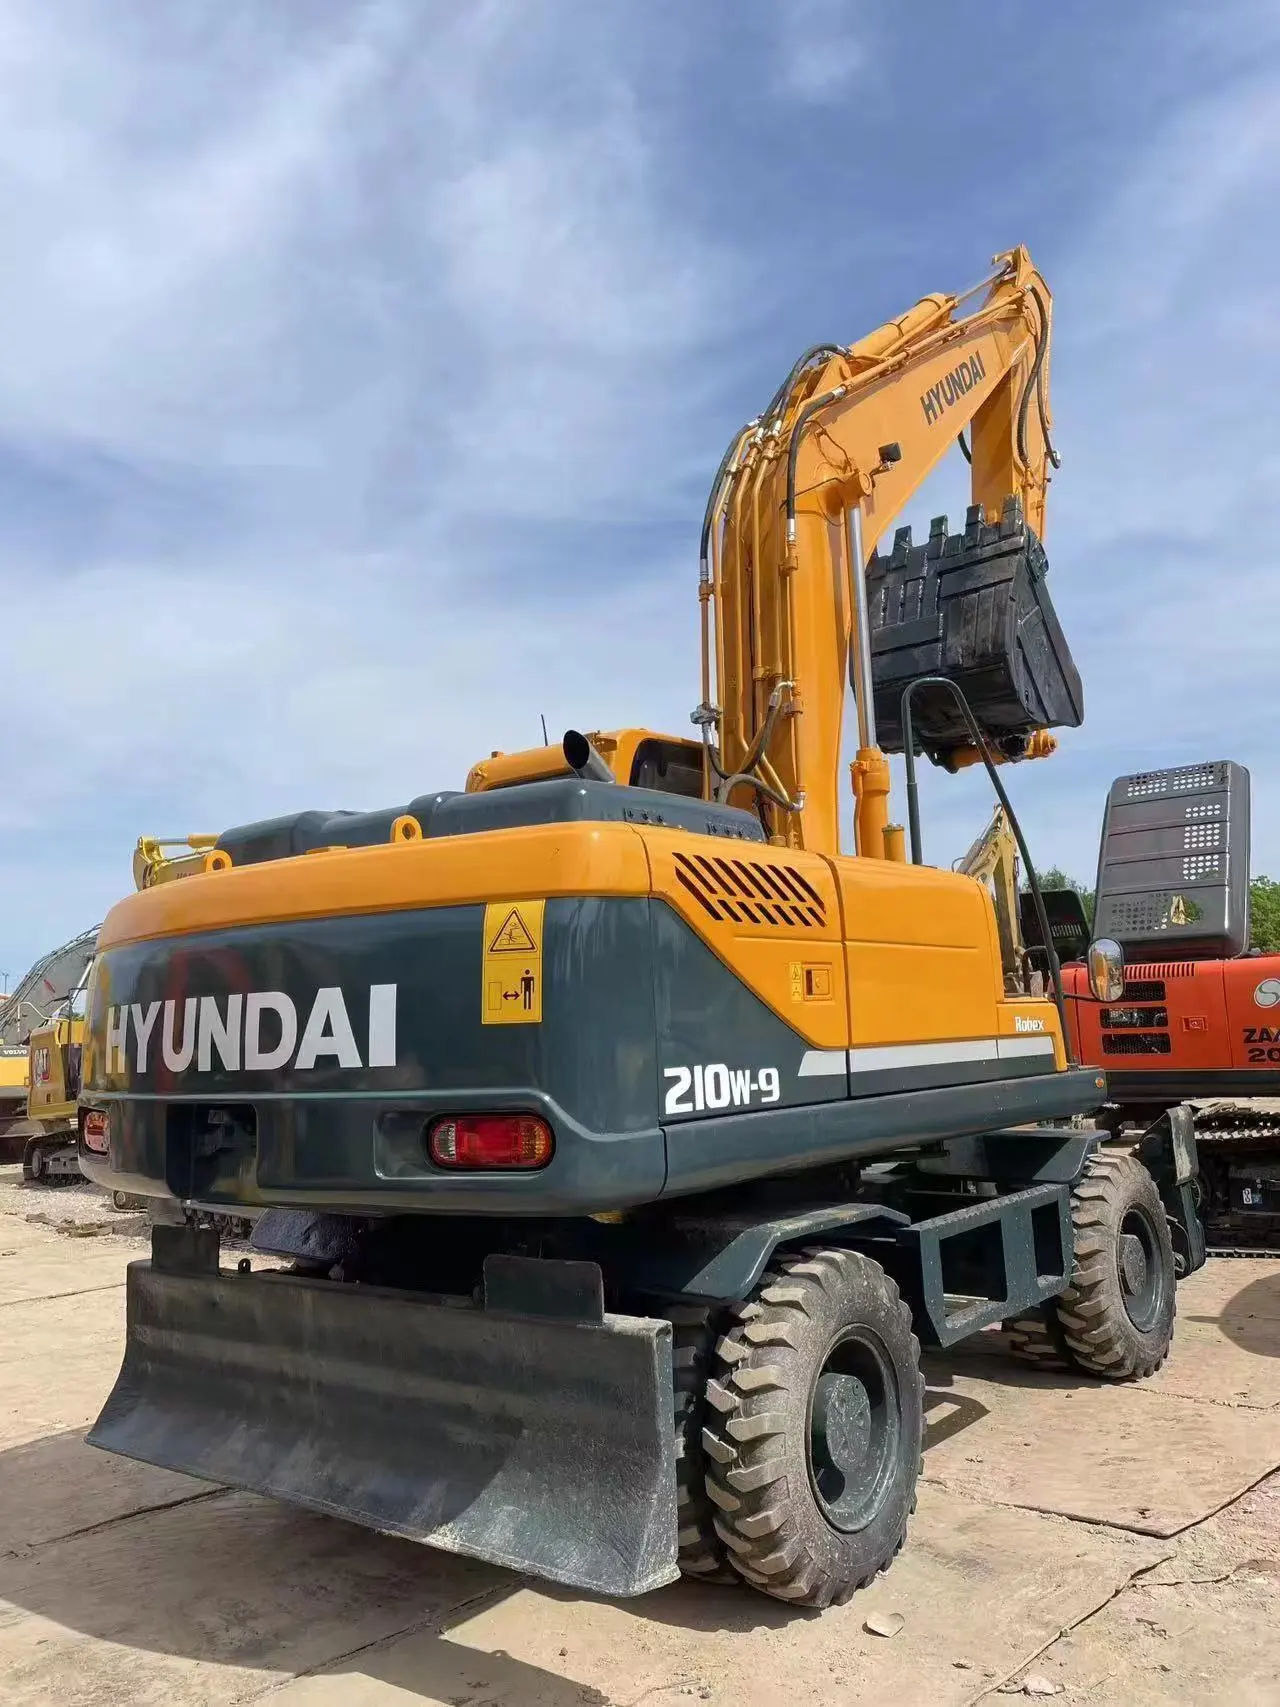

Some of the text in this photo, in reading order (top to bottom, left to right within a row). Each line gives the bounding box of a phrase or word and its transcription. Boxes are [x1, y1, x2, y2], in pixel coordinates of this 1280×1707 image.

[920, 350, 986, 426] HYUNDAI
[105, 983, 398, 1074] HYUNDAI
[1014, 1016, 1045, 1032] Robex
[34, 1048, 49, 1084] CAT
[663, 1063, 780, 1115] 210W-9
